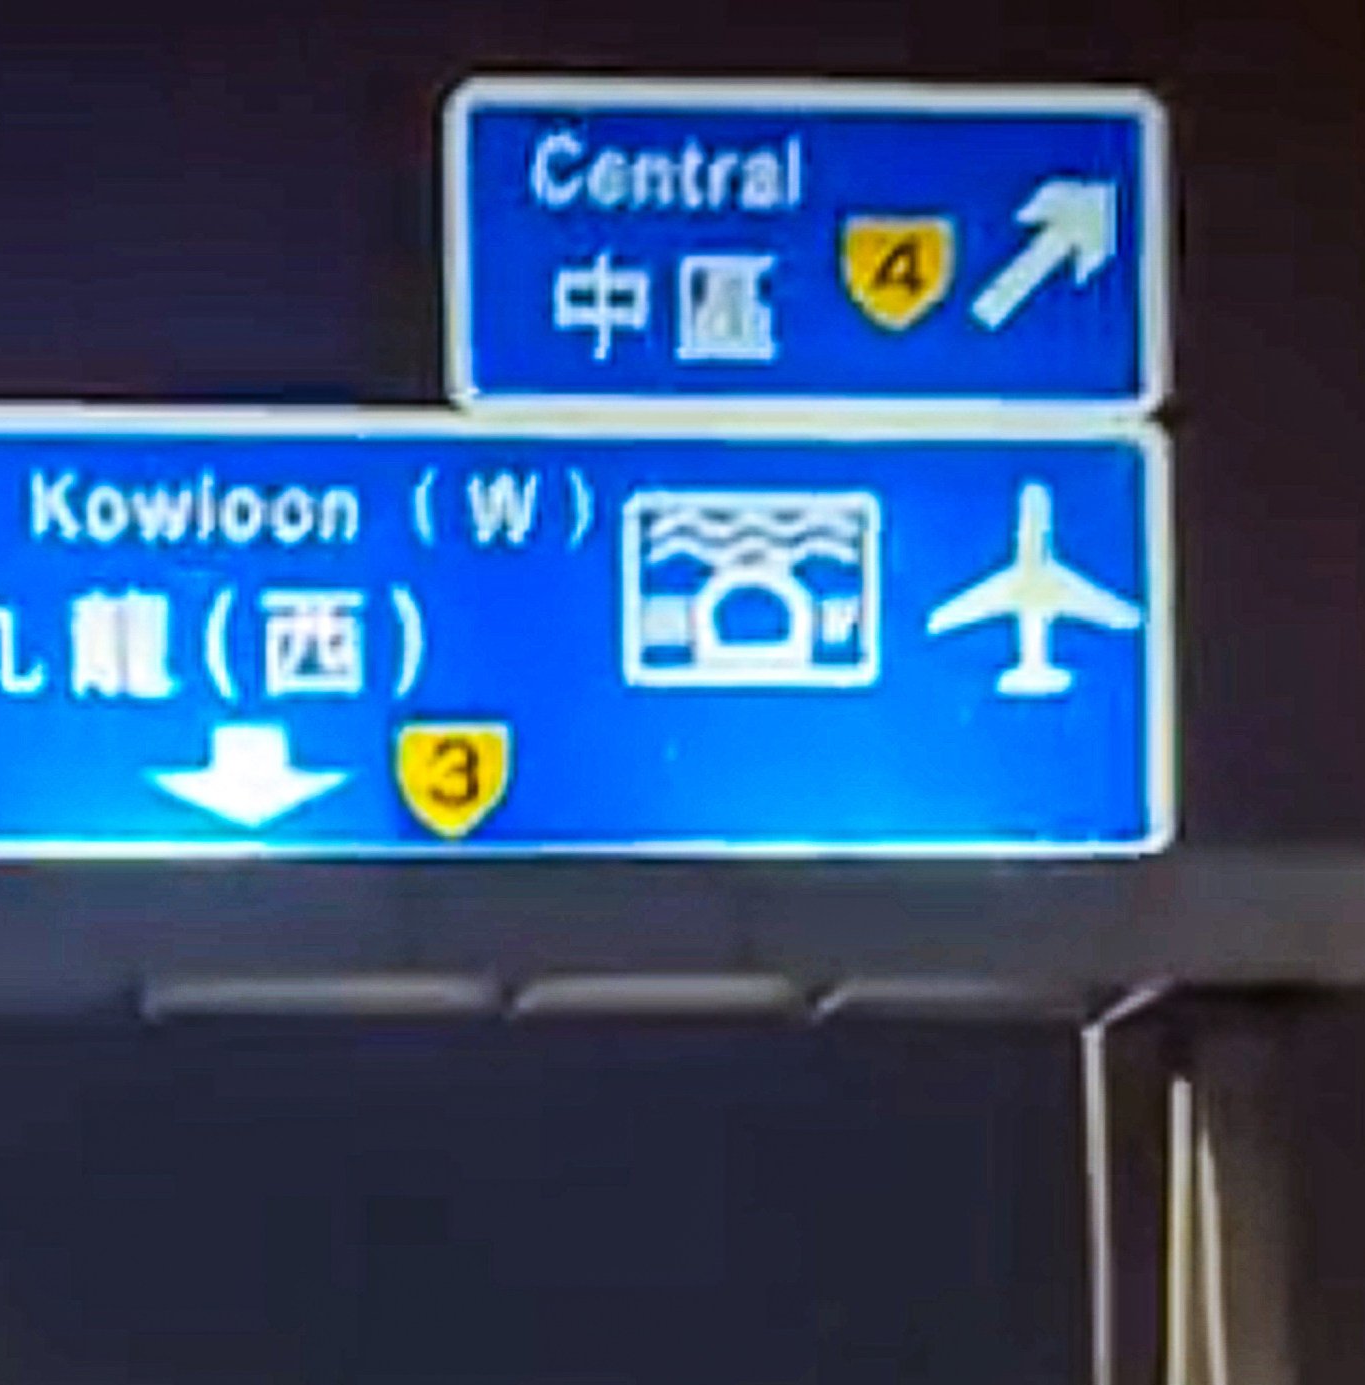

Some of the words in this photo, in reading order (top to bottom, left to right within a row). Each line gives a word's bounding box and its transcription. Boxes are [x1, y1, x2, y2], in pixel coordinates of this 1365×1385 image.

[533, 130, 803, 209] Central
[871, 239, 923, 297] 4
[31, 467, 361, 542] Kowloon
[427, 737, 482, 808] 3
